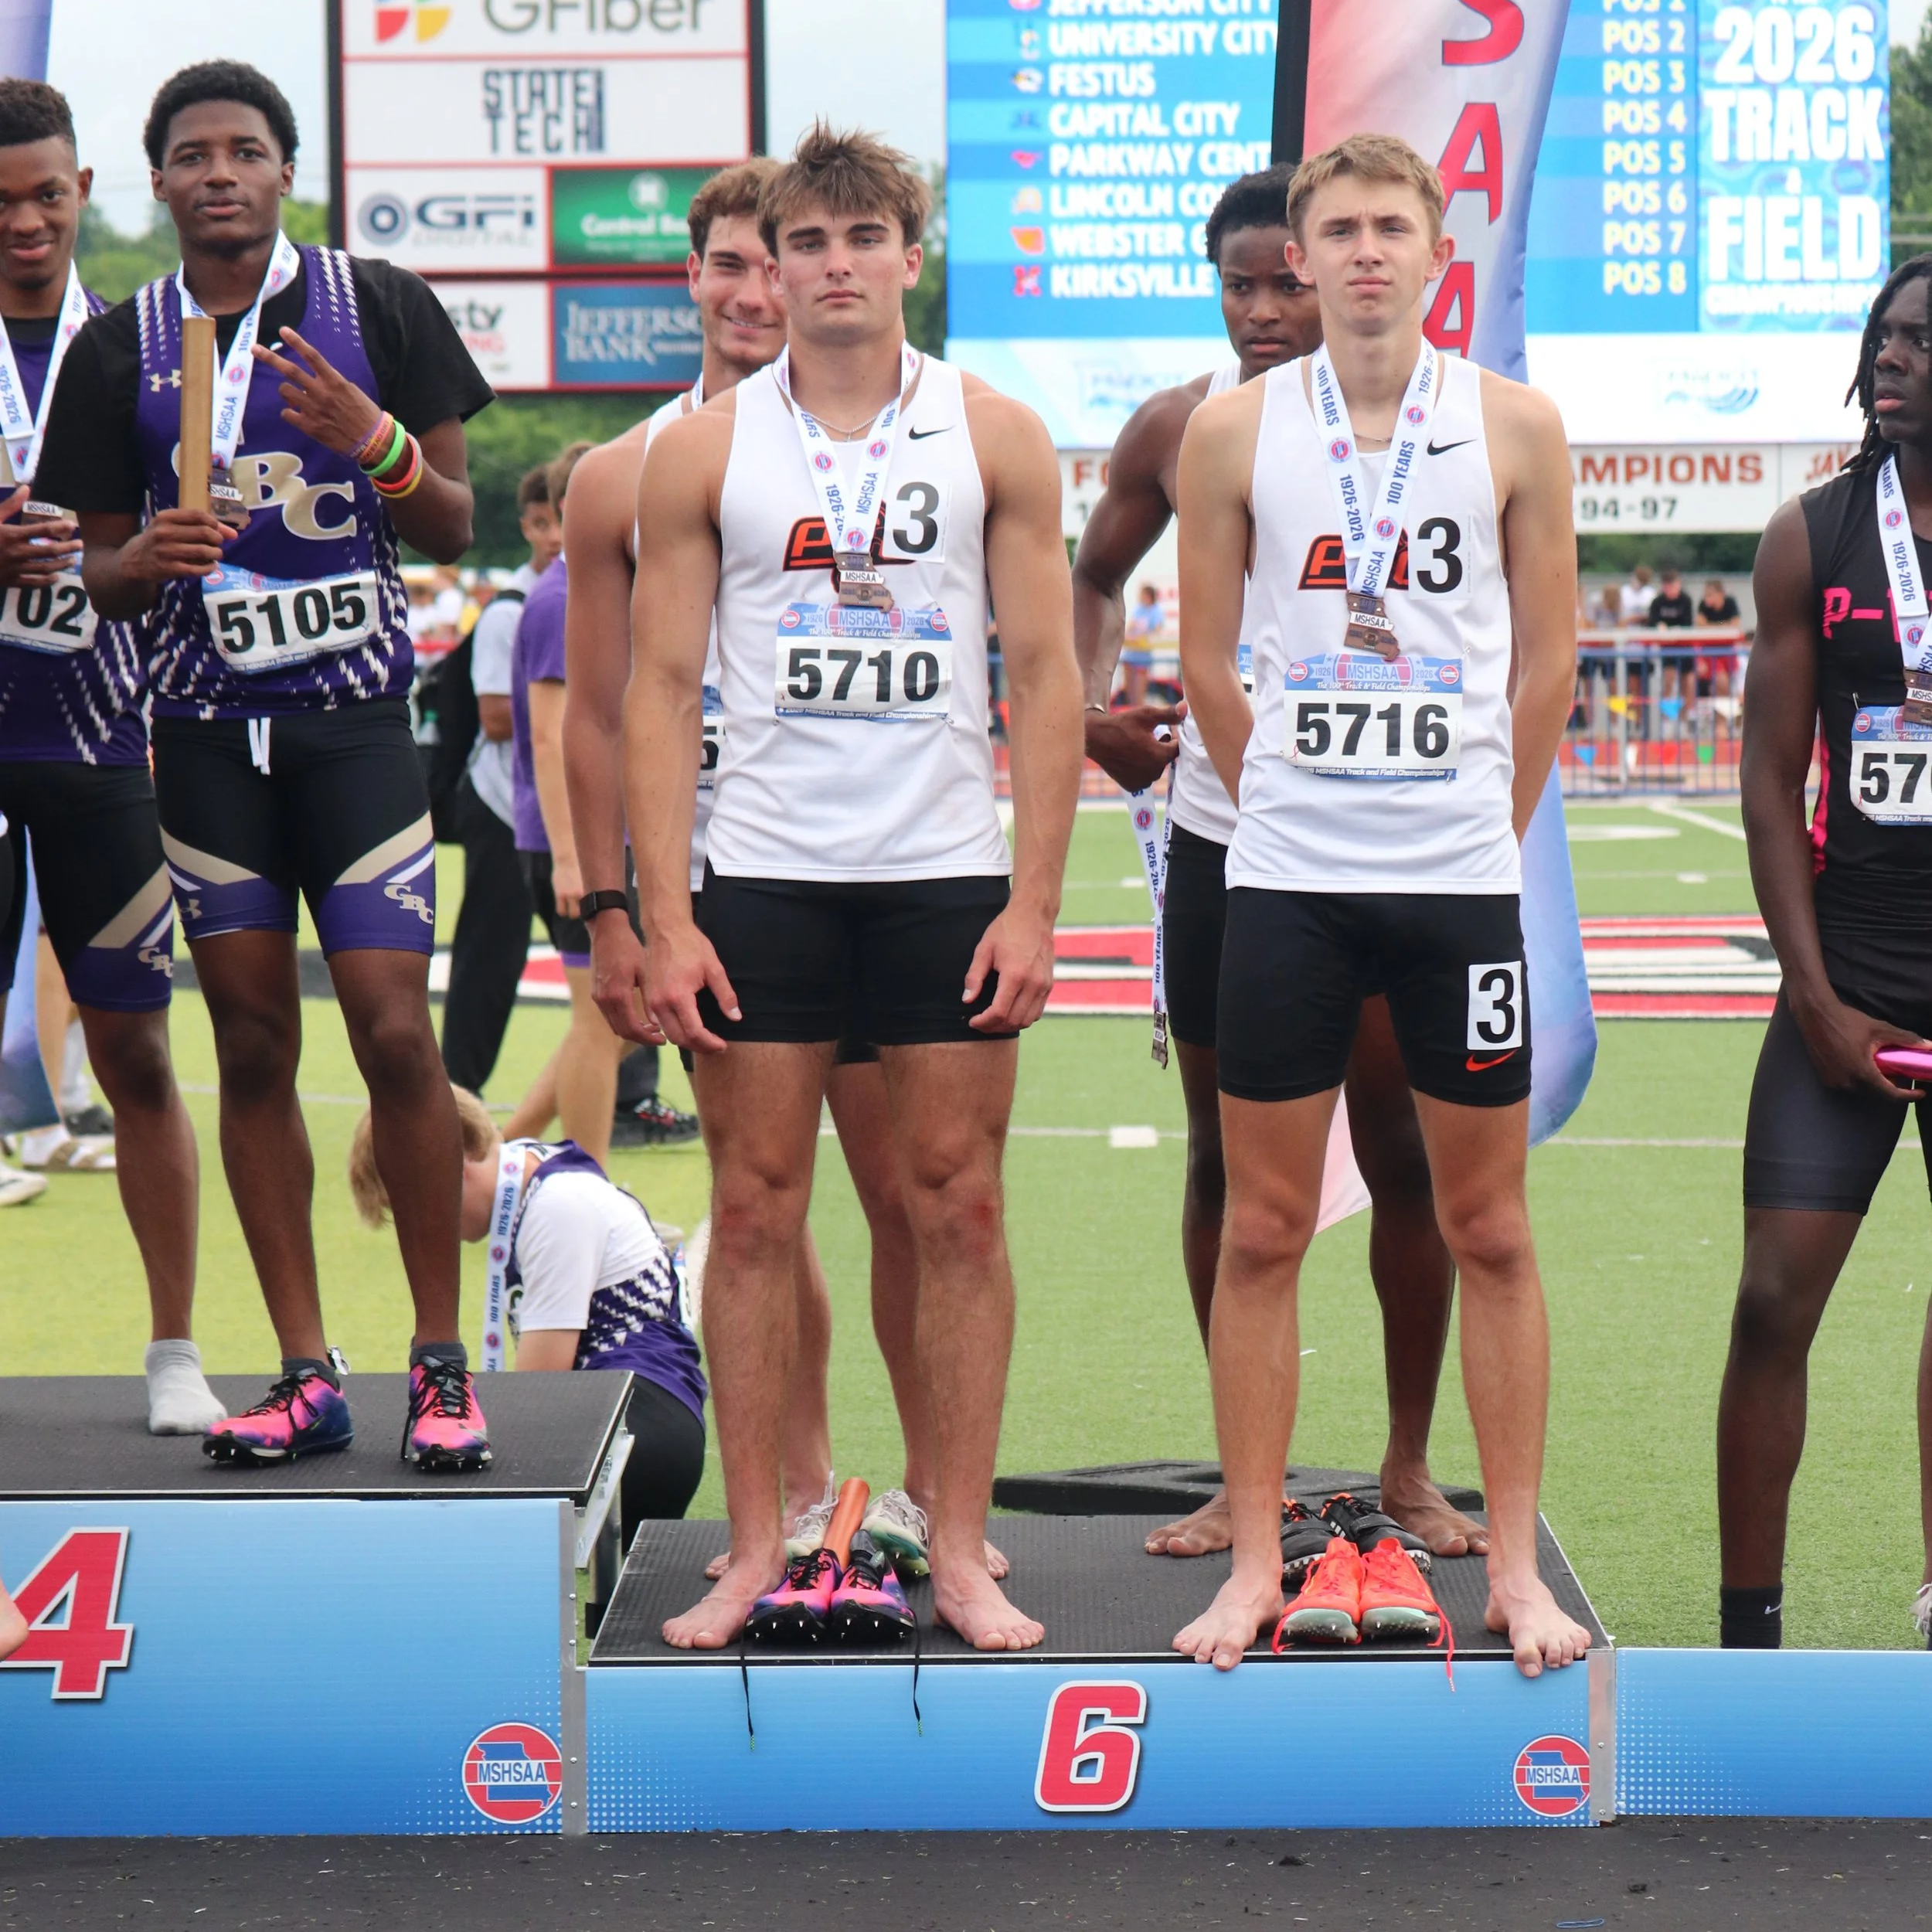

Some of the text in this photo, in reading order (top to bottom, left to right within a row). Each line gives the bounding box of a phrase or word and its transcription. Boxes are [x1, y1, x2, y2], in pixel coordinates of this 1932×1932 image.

[1049, 21, 1217, 56] UNIVERSITY
[1602, 21, 1685, 53] POS 2
[1713, 7, 1875, 83] 2026
[483, 68, 601, 113] STATE
[1049, 62, 1155, 97] FESTUS
[1602, 60, 1685, 94] POS 3
[484, 113, 605, 154] TECH
[1049, 102, 1241, 138] CAPITAL CITY
[1602, 100, 1686, 134] POS 4
[1703, 88, 1886, 162] TRACK
[1049, 142, 1195, 176] PARKWAY
[1602, 141, 1685, 174] POS 5
[1049, 182, 1226, 217] LINCOLN CO
[1602, 181, 1686, 214] POS 6
[1049, 222, 1185, 257] WEBSTER
[1602, 221, 1685, 254] POS 7
[1706, 196, 1882, 282] FIELD
[1049, 264, 1216, 298] KIRKSVILLE
[1602, 261, 1686, 294] POS 8
[565, 333, 658, 366] BANK
[1316, 364, 1339, 426] 100 YEARS
[215, 396, 238, 440] MSHSAA
[800, 412, 821, 438] EARS
[881, 408, 896, 430] 100
[1386, 440, 1415, 505] 100 YEARS
[1573, 452, 1764, 484] MPIONS
[171, 440, 358, 540] BC
[209, 485, 236, 498] SHSAA
[855, 472, 879, 515] MSHSAA
[893, 481, 940, 554] 3
[1339, 474, 1366, 542] 1926-2026
[1417, 517, 1463, 594] 3
[1892, 540, 1917, 602] 1926-2026
[845, 572, 877, 583] MSHSAA
[1360, 550, 1386, 597] MSHSAA
[0, 585, 89, 638] 02
[217, 582, 366, 654] 5105
[838, 611, 890, 628] MSHSAA
[1354, 613, 1386, 629] MSHSAA
[862, 628, 876, 638] Field
[876, 629, 922, 641] Championships
[786, 648, 940, 702] 5710
[1315, 668, 1331, 677] 1926
[1346, 664, 1399, 681] MSHSAA
[1415, 669, 1434, 679] 2026
[1316, 682, 1328, 690] The
[1345, 682, 1362, 691] Track
[1372, 682, 1386, 691] Field
[1386, 683, 1431, 695] Championships
[1295, 702, 1449, 758] 5716
[1397, 768, 1446, 777] Championships
[1860, 753, 1932, 804] 57
[1476, 968, 1515, 1044] 3
[497, 1186, 514, 1236] 1926-2026
[490, 1275, 502, 1324] 100 YEARS
[0, 1526, 134, 1700] 4
[1034, 1679, 1148, 1813] 6
[478, 1761, 547, 1784] MSHSAA
[1526, 1766, 1580, 1785] MSHSAA
